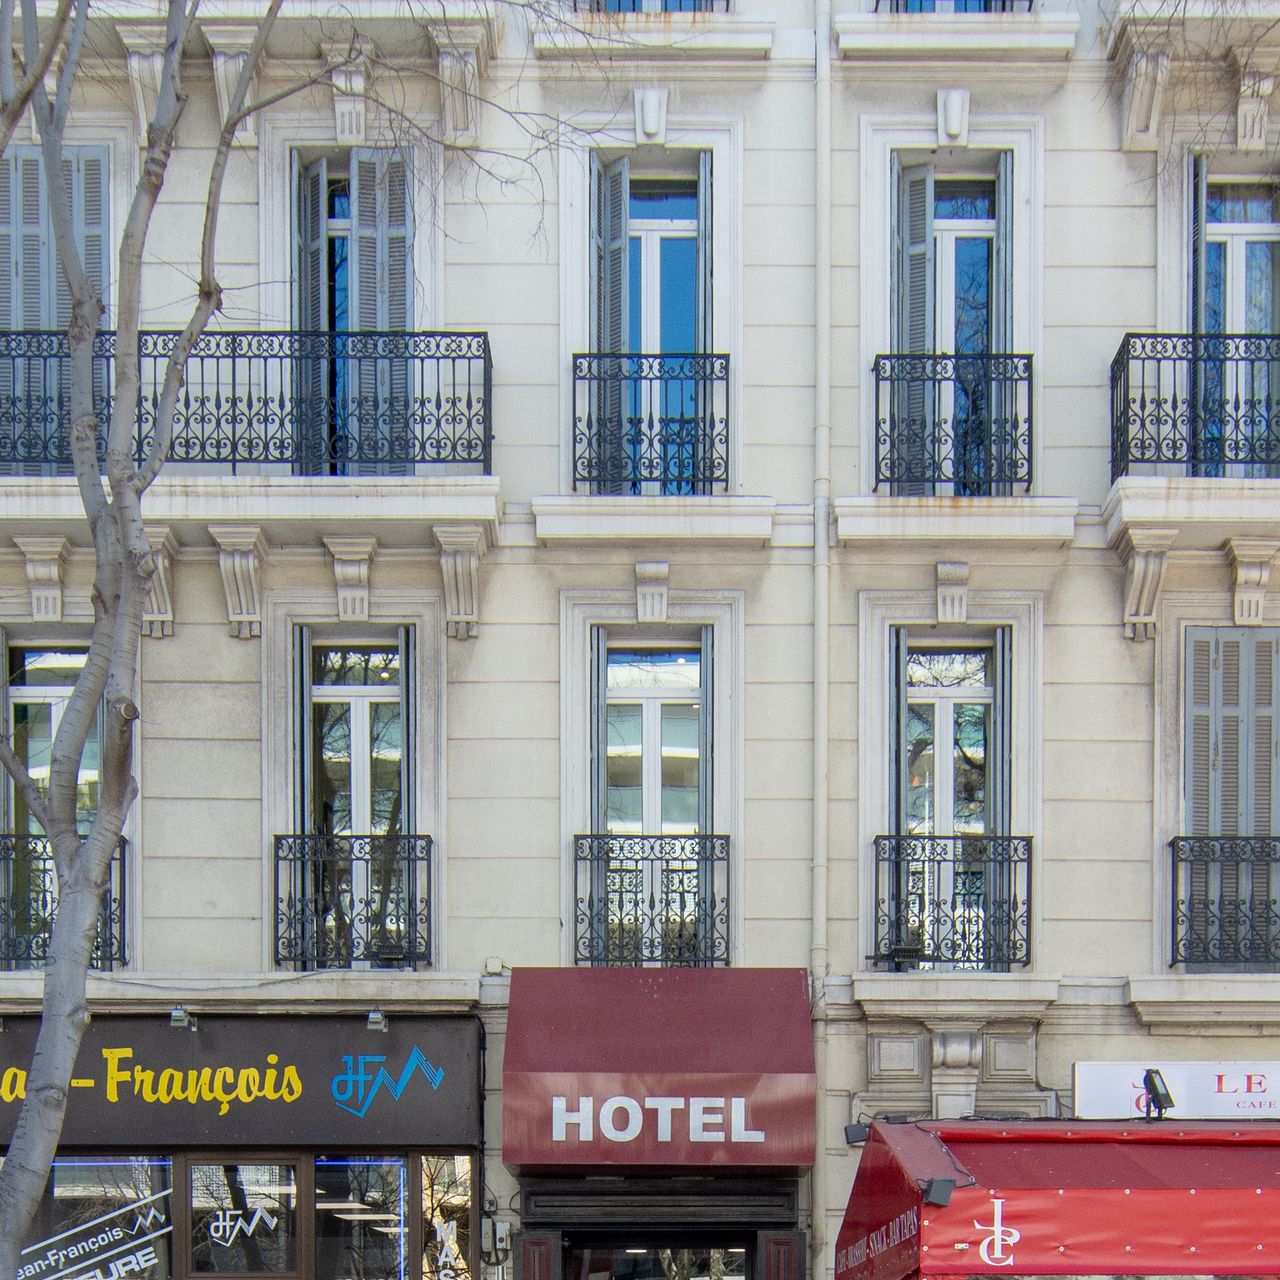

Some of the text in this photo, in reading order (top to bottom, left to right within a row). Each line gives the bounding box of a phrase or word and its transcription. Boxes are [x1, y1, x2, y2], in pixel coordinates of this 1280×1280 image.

[1214, 1073, 1268, 1094] LE
[552, 1096, 765, 1142] HOTEL
[900, 1205, 918, 1241] TAPAS
[17, 1228, 123, 1280] ean-François
